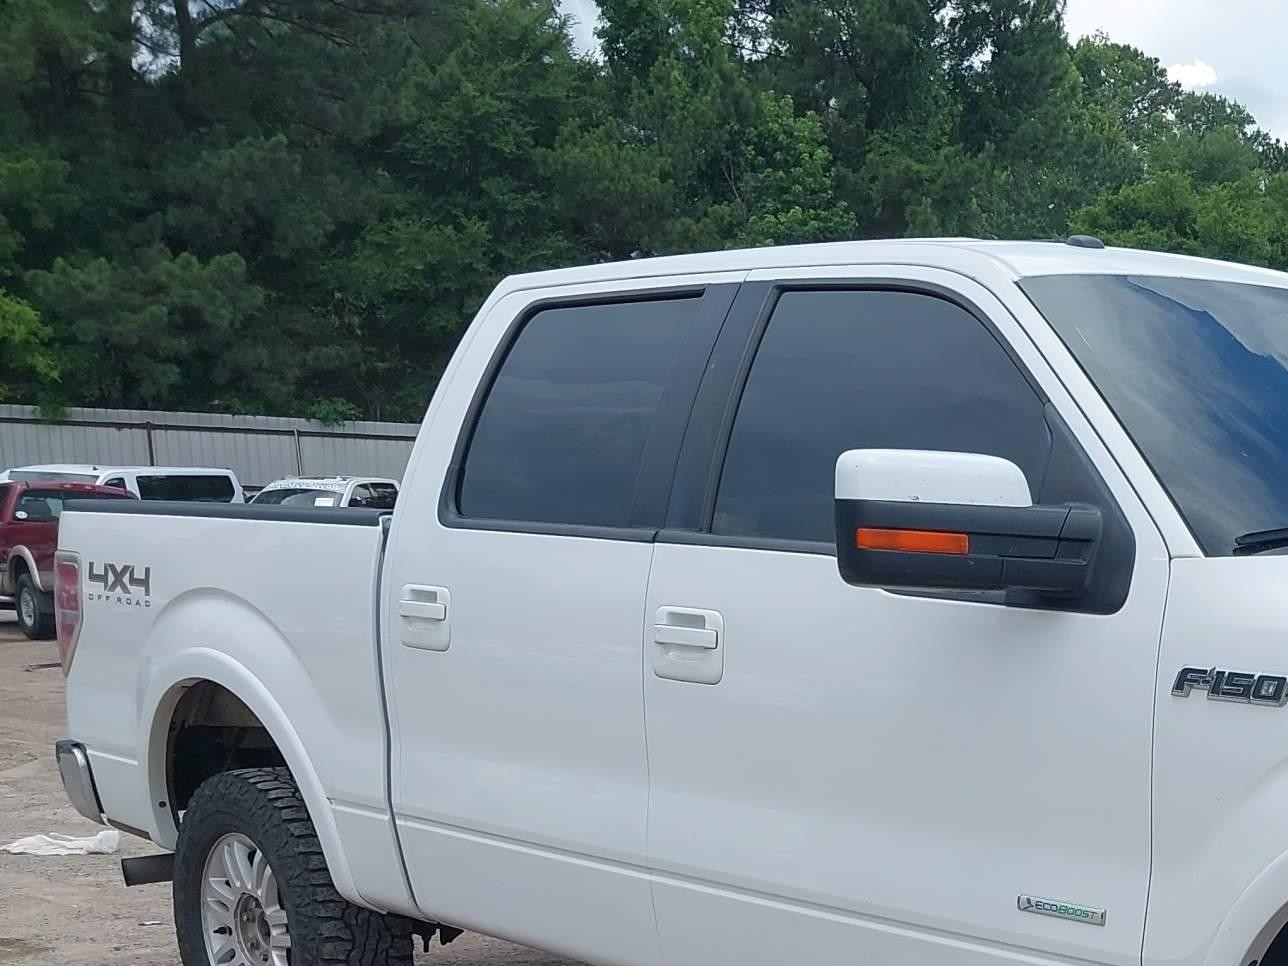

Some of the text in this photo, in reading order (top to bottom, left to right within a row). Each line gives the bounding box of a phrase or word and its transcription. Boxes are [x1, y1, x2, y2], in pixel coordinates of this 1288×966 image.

[88, 593, 151, 608] OFF ROAD
[1034, 900, 1098, 920] ECOBOOST
